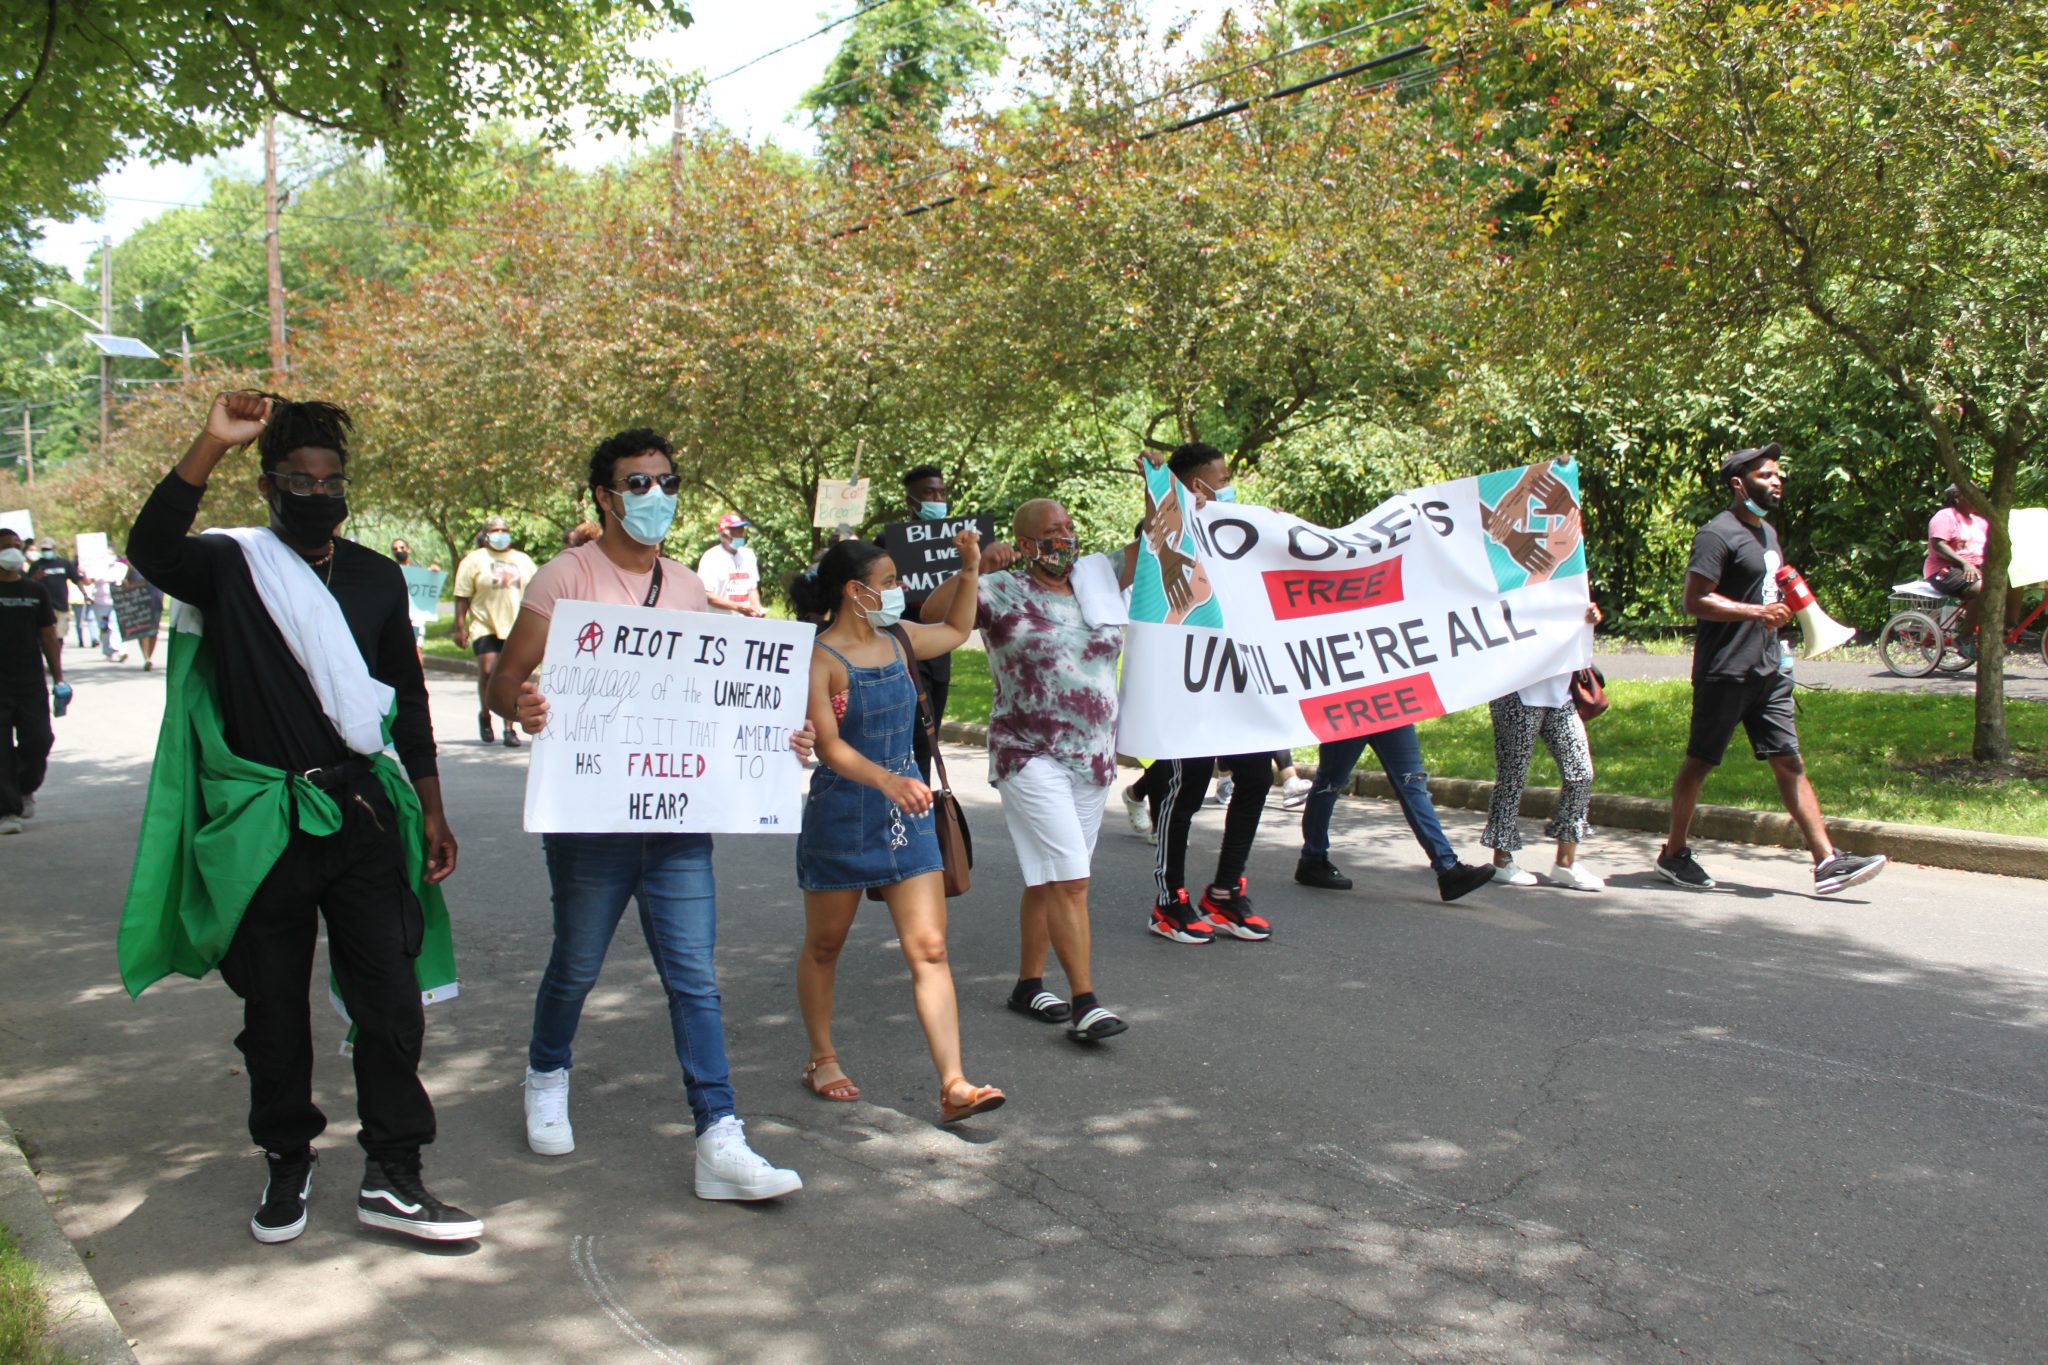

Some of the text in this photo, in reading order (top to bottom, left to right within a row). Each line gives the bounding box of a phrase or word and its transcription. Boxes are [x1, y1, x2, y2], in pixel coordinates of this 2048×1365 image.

[906, 518, 983, 543] BLACK
[1190, 500, 1454, 561] NO ONE'S
[924, 546, 960, 562] LIVE
[1283, 570, 1385, 608] FREE
[613, 625, 683, 661] RIOT
[693, 634, 727, 666] IS
[745, 639, 794, 675] THE
[1183, 599, 1537, 695] UNTIL WE'RE ALL
[543, 663, 641, 724] Language
[651, 674, 674, 701] of
[682, 676, 701, 704] the
[1323, 687, 1423, 732] FREE
[564, 711, 611, 744] WHAT
[619, 715, 644, 745] IS
[651, 717, 679, 746] IT
[687, 719, 721, 749] THAT
[733, 723, 792, 753] AMERIC
[575, 752, 764, 781] HAS FAILED TO
[629, 792, 689, 825] HEAR?
